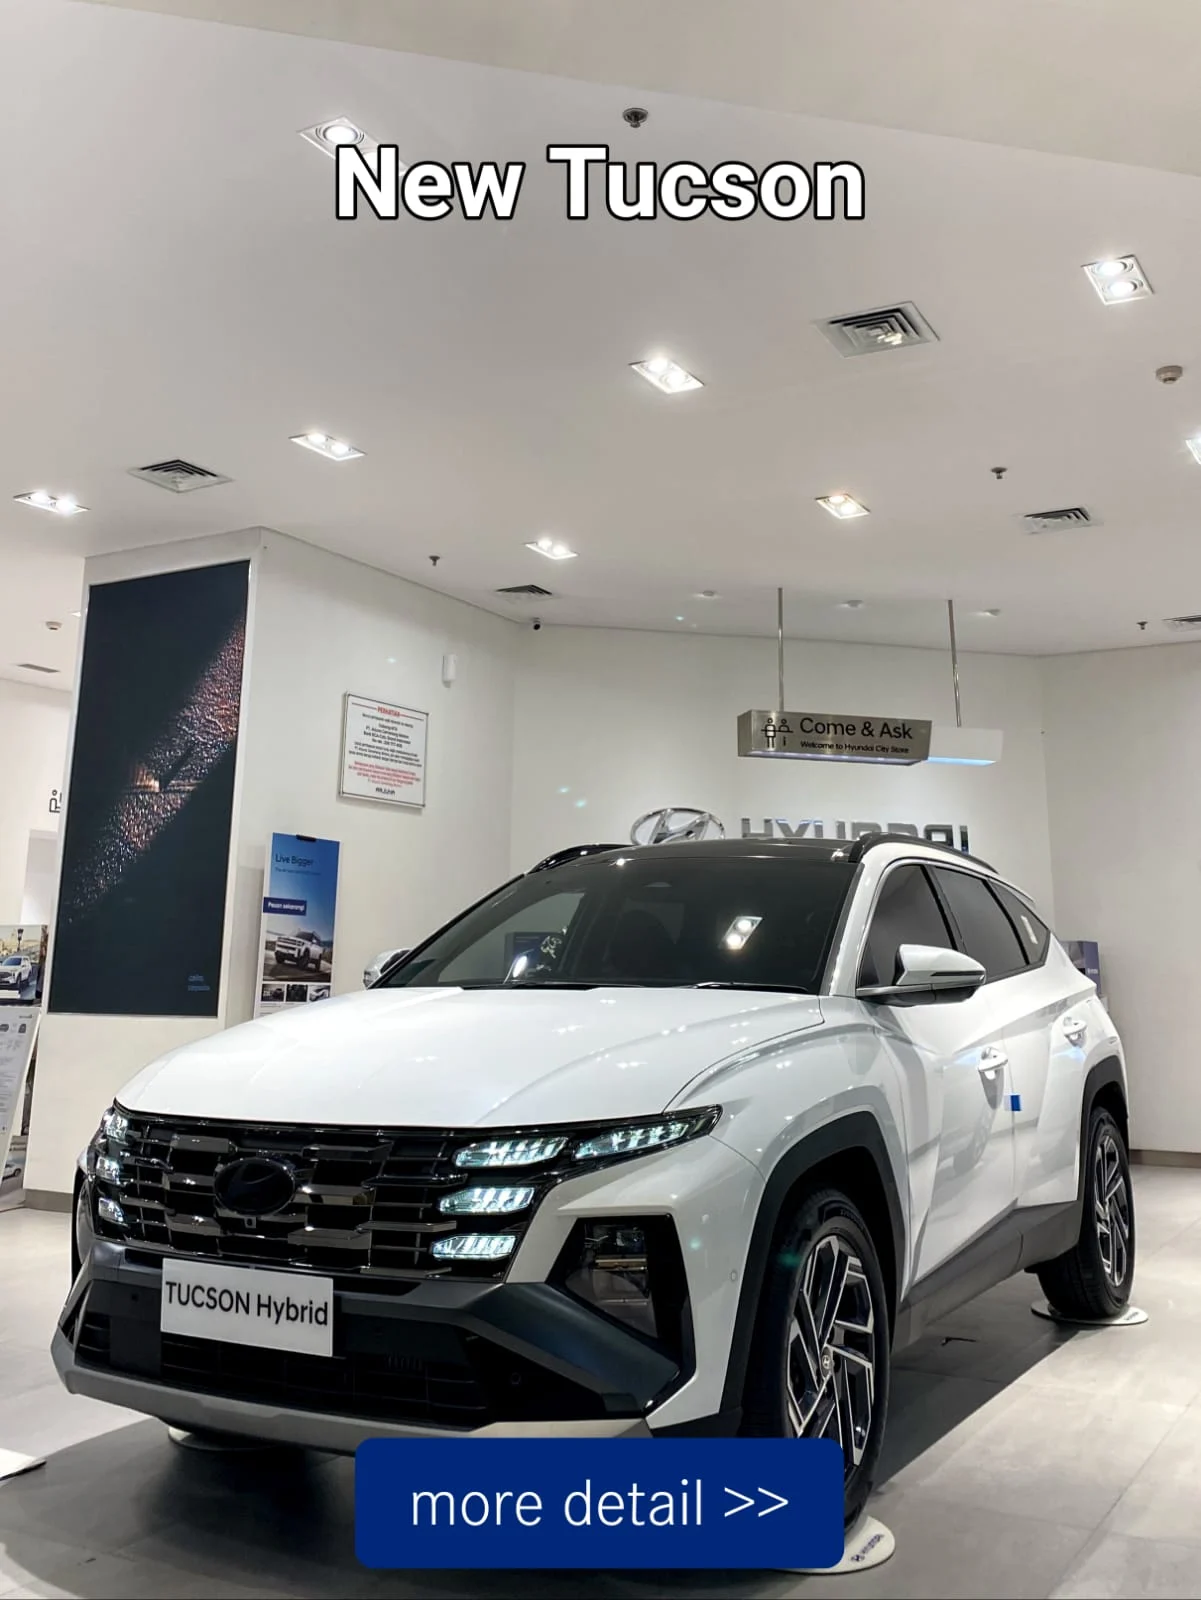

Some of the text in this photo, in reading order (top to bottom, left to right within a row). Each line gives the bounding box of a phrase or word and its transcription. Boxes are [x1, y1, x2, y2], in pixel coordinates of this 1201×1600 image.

[800, 717, 914, 740] Come & Ask
[800, 740, 910, 755] Welcome to Hyundai City Store
[165, 1281, 328, 1326] TUCSON Hybrid
